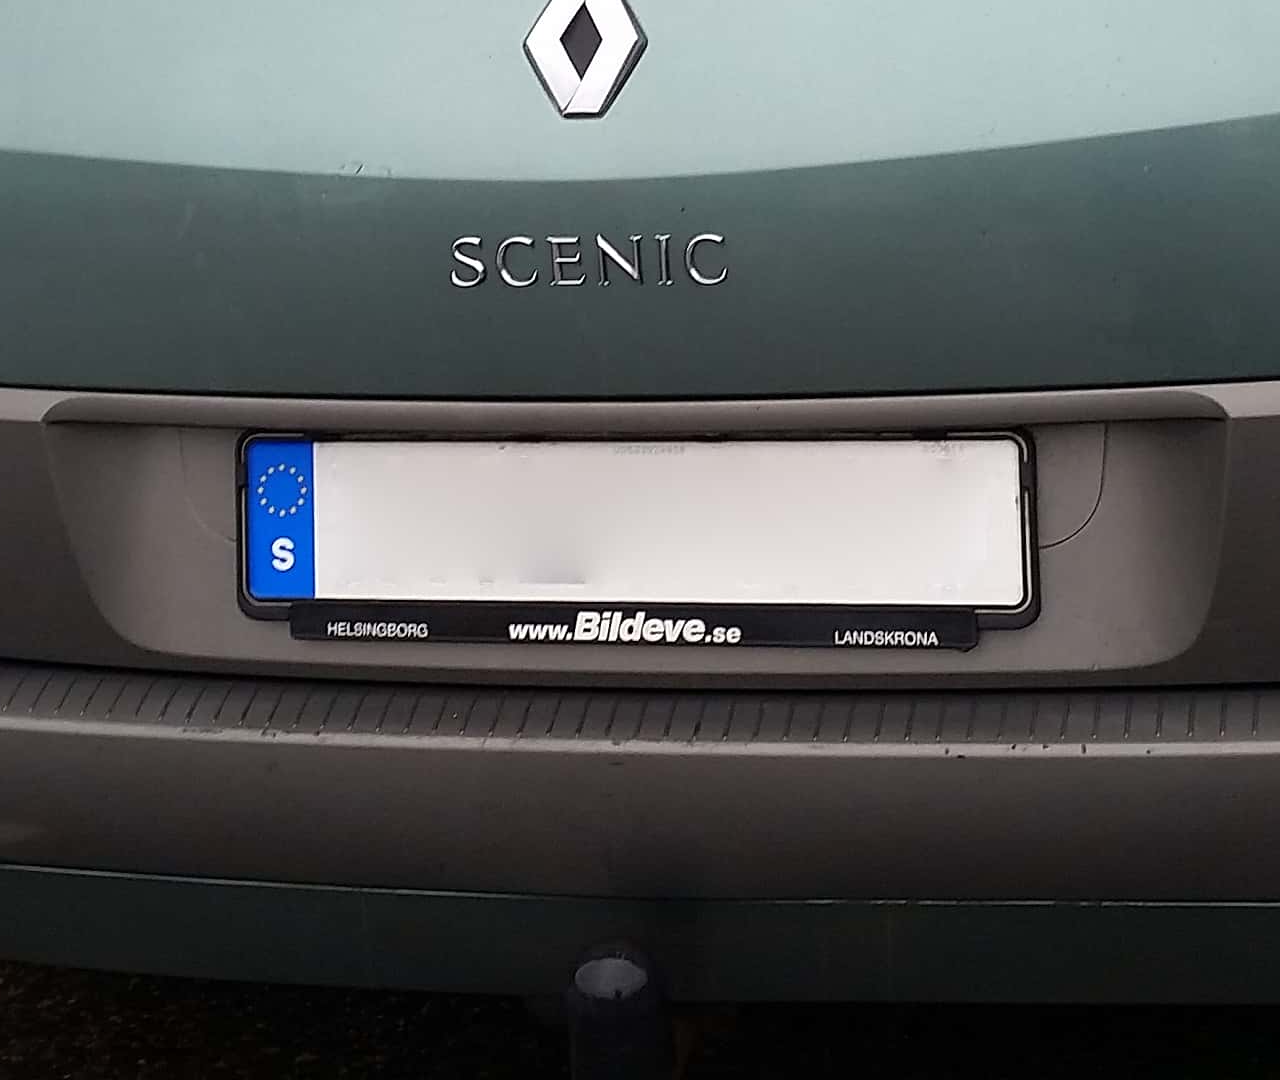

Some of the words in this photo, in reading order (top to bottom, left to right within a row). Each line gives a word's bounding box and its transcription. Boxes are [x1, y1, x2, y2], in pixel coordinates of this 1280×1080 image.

[450, 233, 729, 288] SCENIC
[271, 537, 296, 572] S
[326, 620, 429, 639] HELSINGBORG
[508, 610, 742, 644] www.Bildeve.se
[833, 628, 939, 647] LANDSKRONA
